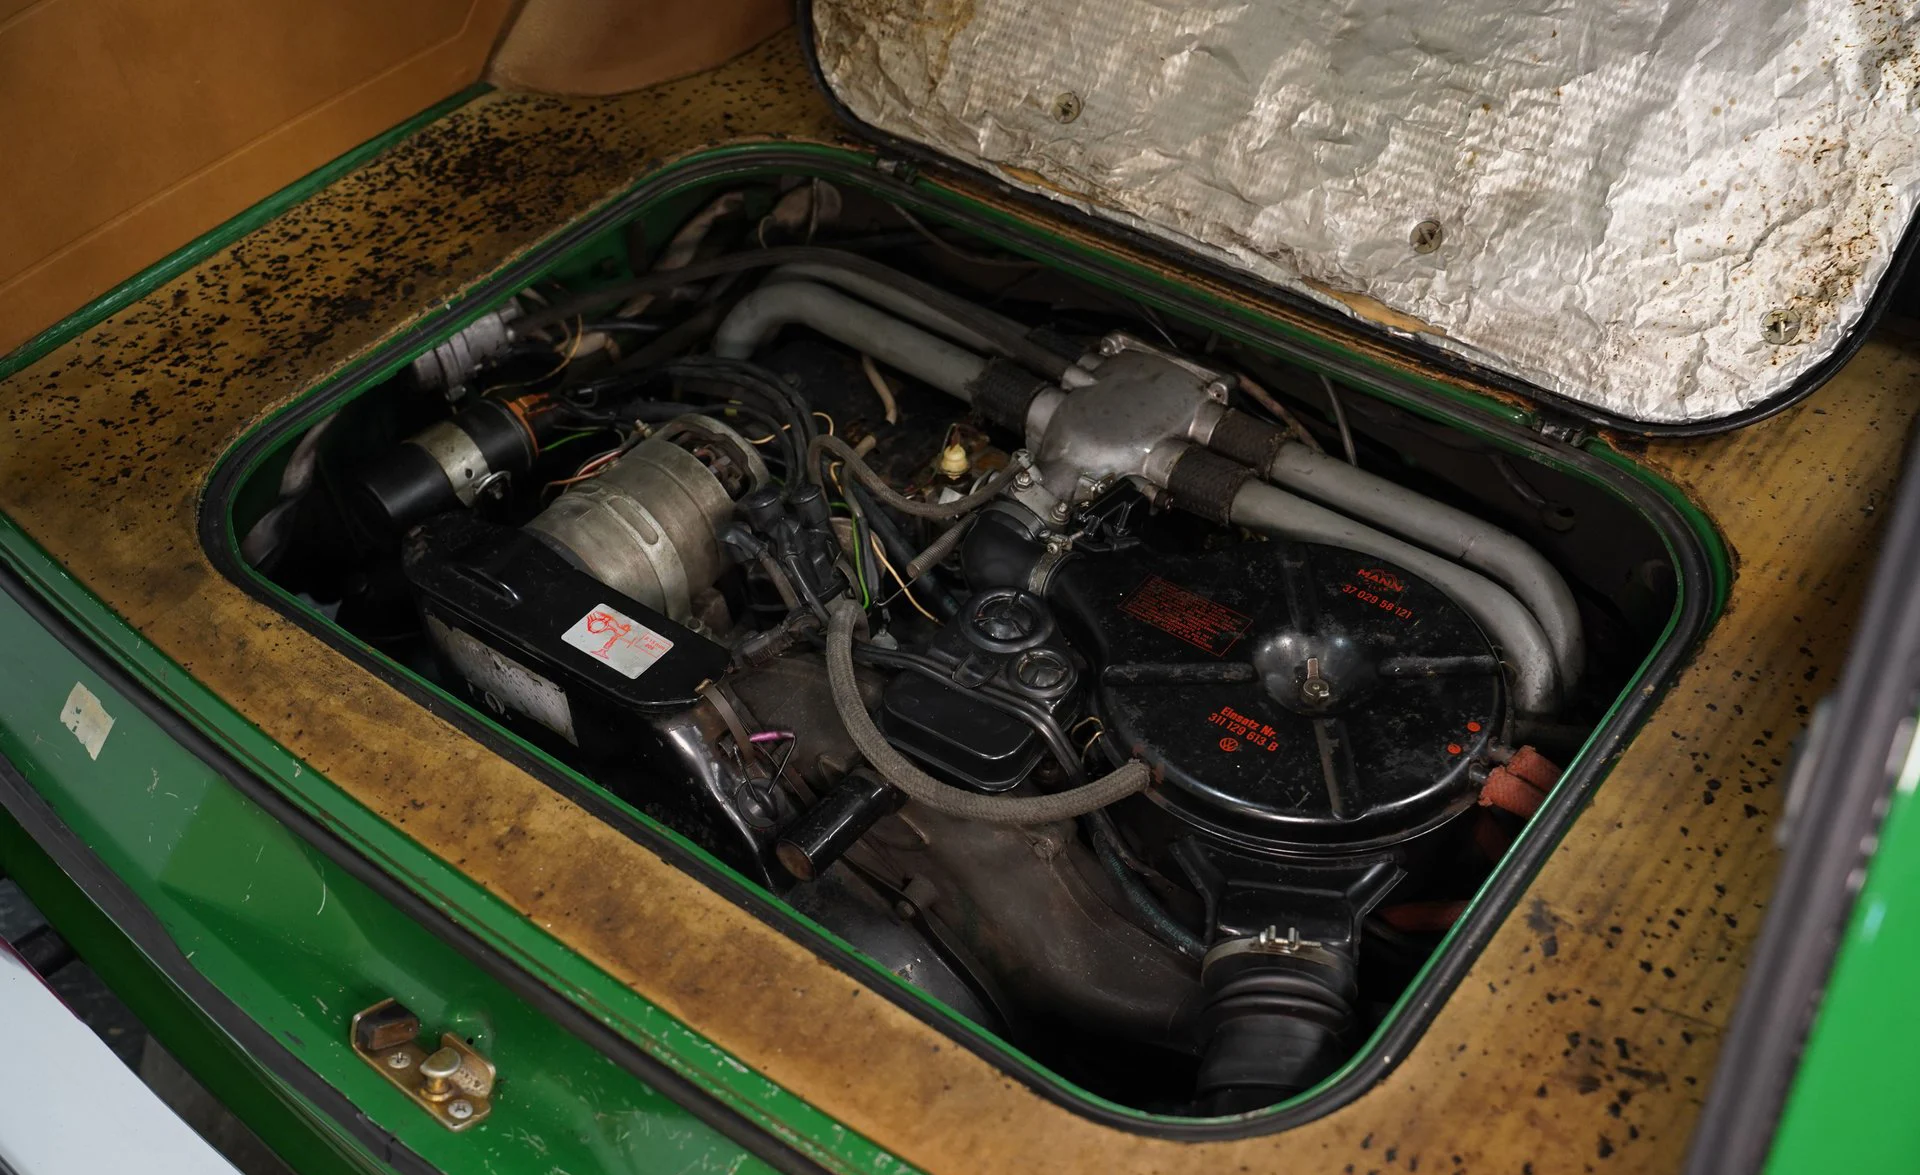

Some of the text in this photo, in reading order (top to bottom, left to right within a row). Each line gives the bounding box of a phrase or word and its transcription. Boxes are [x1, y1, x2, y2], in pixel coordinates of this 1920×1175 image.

[1357, 569, 1403, 592] MANN
[1342, 584, 1358, 594] 37
[1357, 590, 1379, 604] 029
[1379, 599, 1395, 611] 58
[1394, 606, 1413, 619] 121
[1207, 712, 1279, 752] 311 129 613 B
[1220, 706, 1277, 739] Einsatz Nr.
